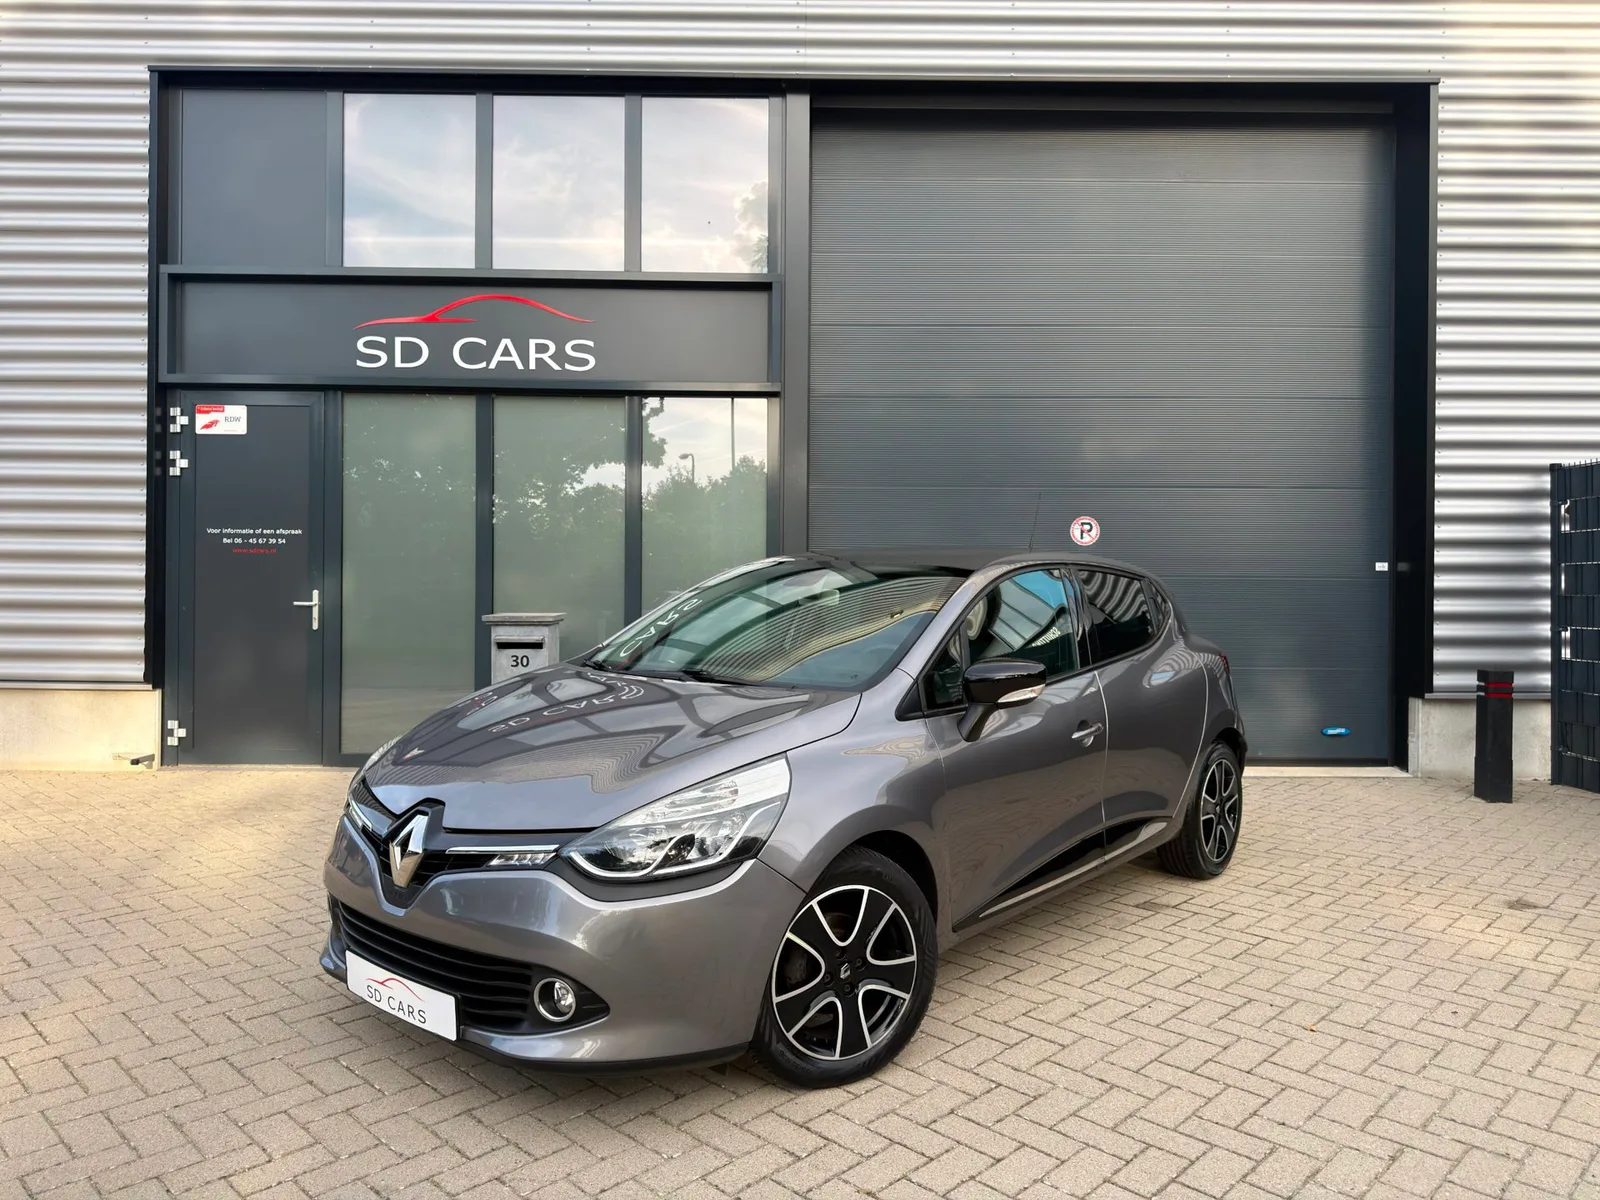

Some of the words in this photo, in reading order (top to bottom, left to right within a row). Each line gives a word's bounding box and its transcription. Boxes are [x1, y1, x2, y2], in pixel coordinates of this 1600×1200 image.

[356, 335, 429, 368] SD
[452, 336, 596, 372] CARS
[275, 528, 302, 536] afspraak
[510, 654, 530, 668] 30
[366, 984, 382, 1003] SD
[387, 995, 427, 1024] CARS
